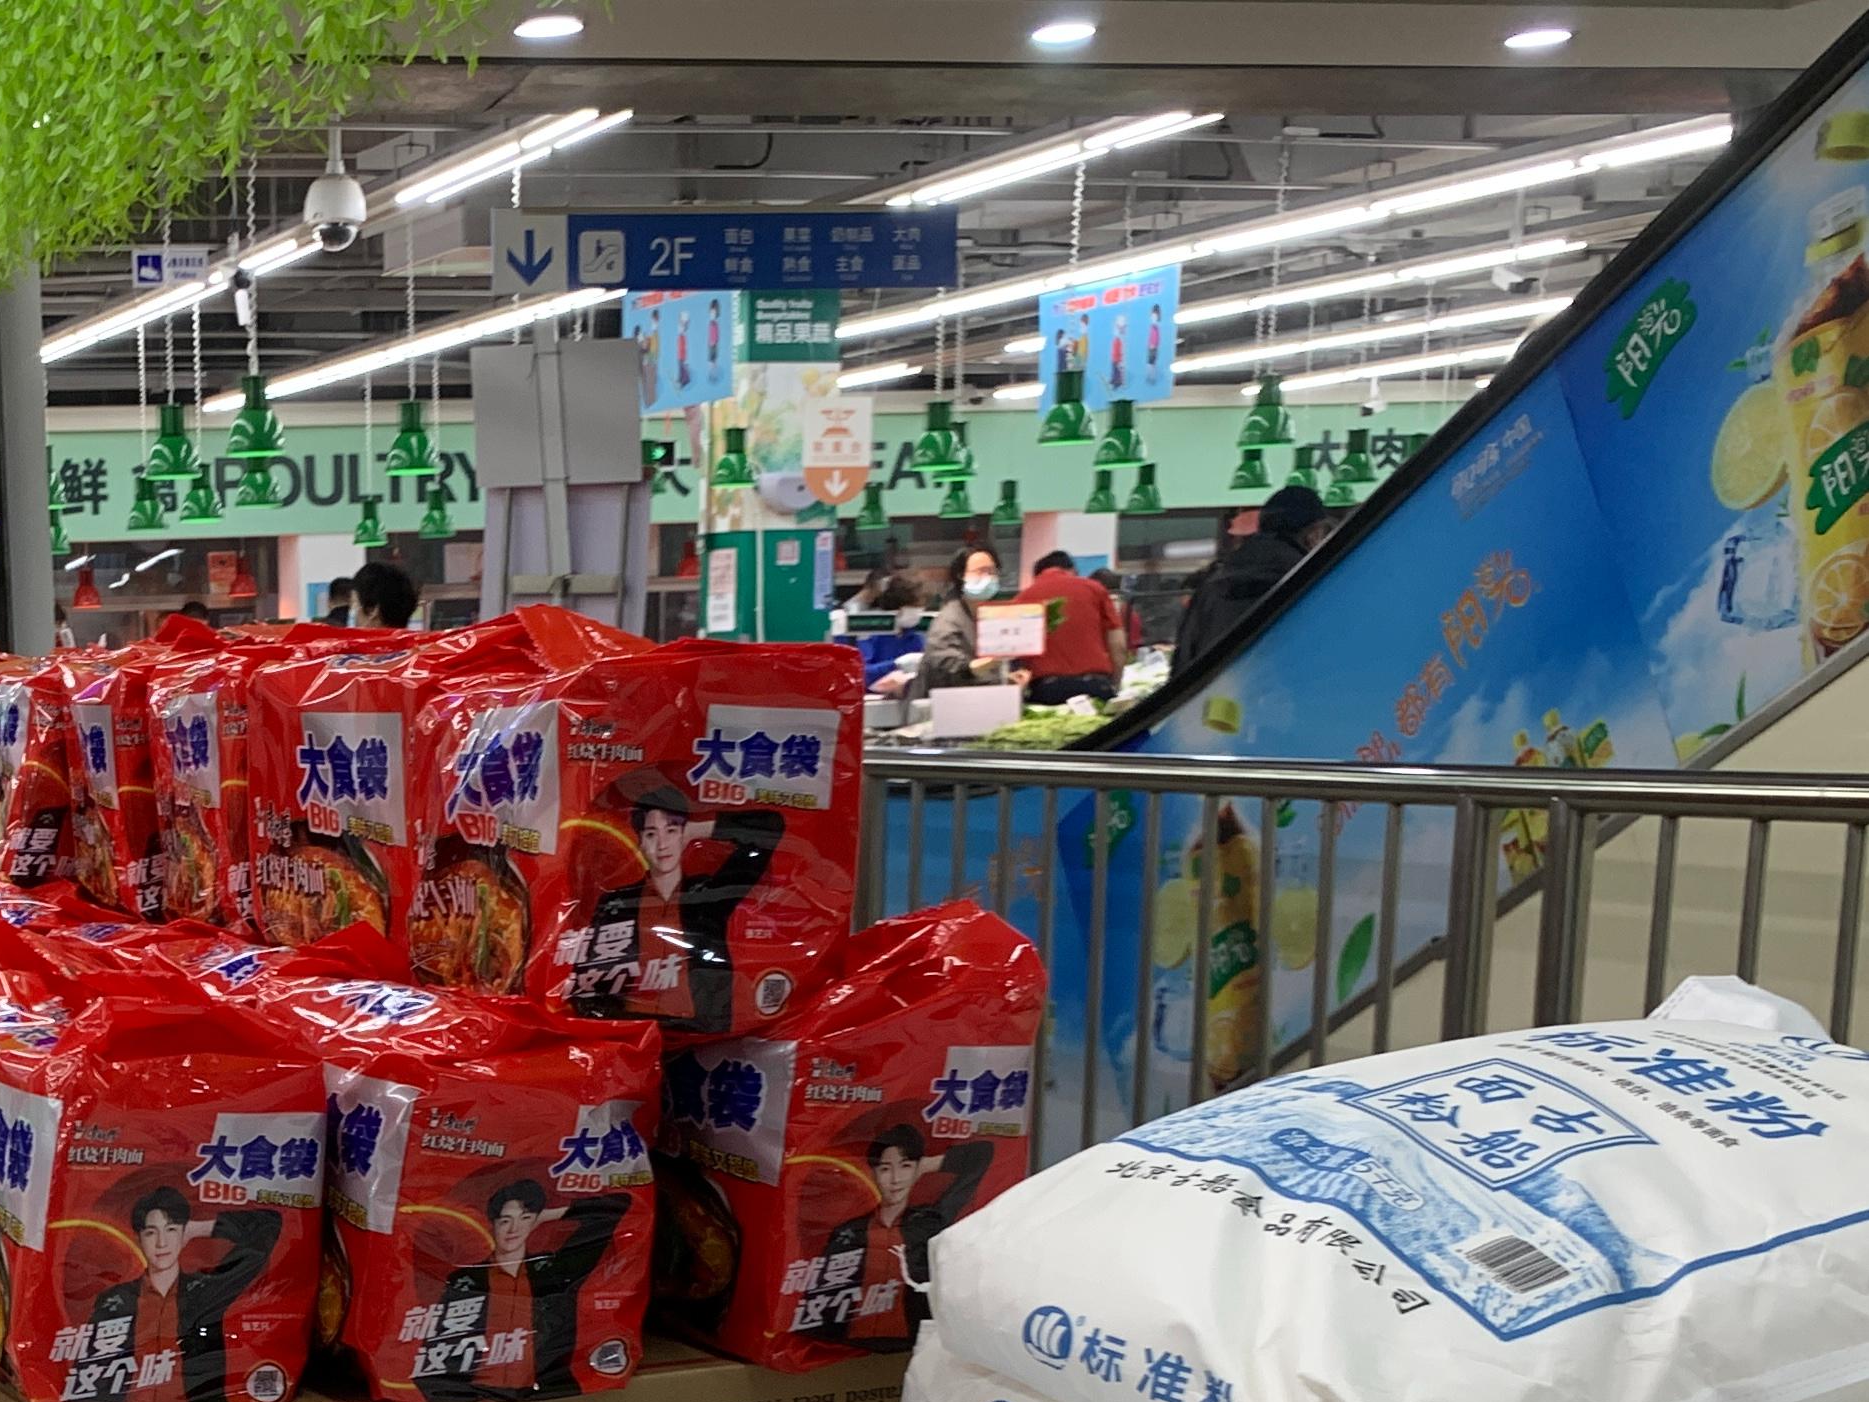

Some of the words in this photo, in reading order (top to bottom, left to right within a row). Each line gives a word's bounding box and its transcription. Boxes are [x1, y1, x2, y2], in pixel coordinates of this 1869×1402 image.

[649, 237, 697, 277] 2F
[298, 732, 389, 806] 大食袋
[688, 729, 822, 783] 大食袋
[701, 779, 746, 804] BIG
[309, 801, 340, 837] BIG
[925, 1069, 1029, 1121] 大食袋
[1525, 1031, 1831, 1138] 标准粉
[421, 1133, 506, 1157] 红烧牛肉面
[934, 1117, 972, 1137] BIG
[190, 1135, 319, 1182] 大食袋
[561, 1173, 601, 1190] BIG
[202, 1180, 247, 1201] BIG
[782, 1250, 864, 1295] 就要
[398, 1296, 486, 1344] 就要
[788, 1281, 901, 1333] 这个味
[50, 1316, 134, 1362] 就要
[409, 1326, 537, 1380] 这个味
[60, 1350, 184, 1402] 这个味
